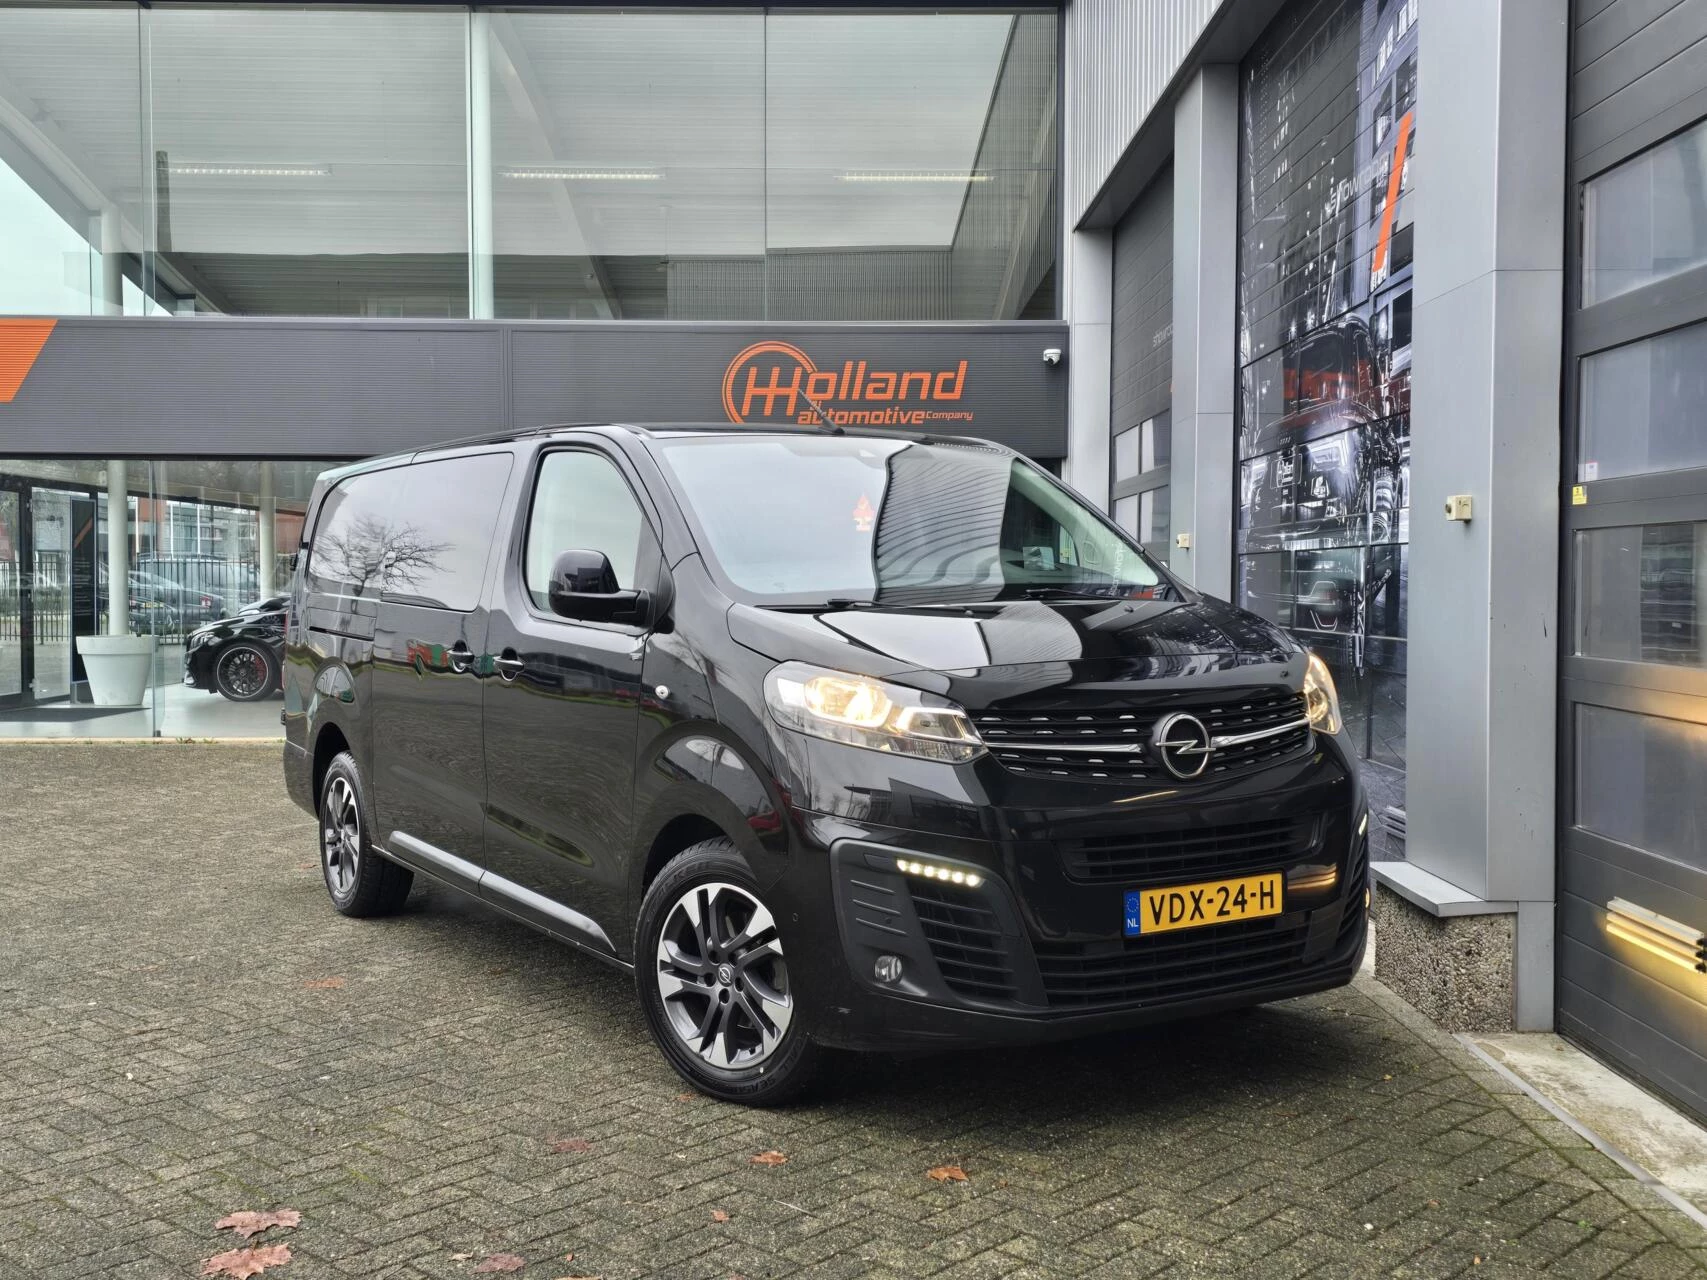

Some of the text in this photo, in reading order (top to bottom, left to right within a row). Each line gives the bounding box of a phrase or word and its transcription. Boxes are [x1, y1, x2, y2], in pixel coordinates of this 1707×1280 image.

[797, 406, 973, 424] automotive Company
[1149, 880, 1274, 925] VDX-24-H
[1127, 918, 1139, 928] NL
